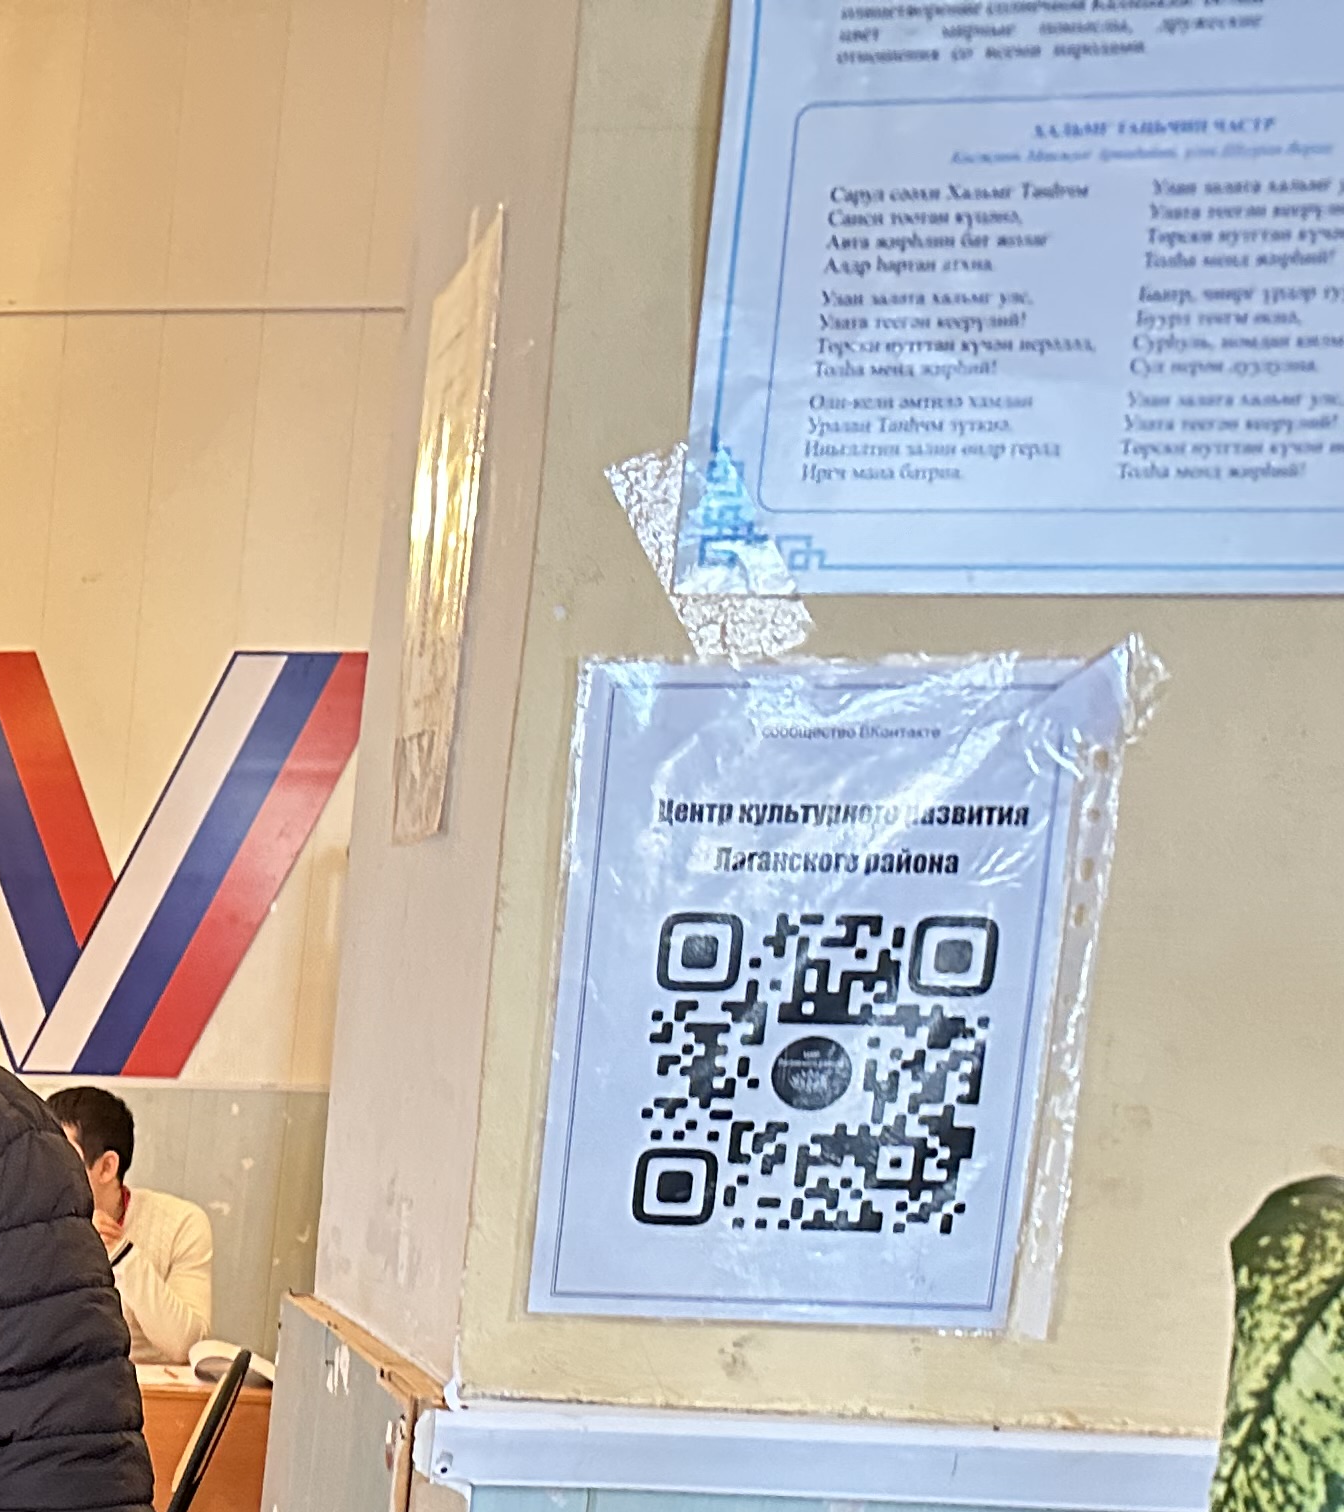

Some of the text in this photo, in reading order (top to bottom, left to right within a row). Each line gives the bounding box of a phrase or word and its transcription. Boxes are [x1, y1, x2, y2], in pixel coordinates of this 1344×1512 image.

[657, 797, 733, 827] Центр
[714, 846, 960, 877] Лаганского района
